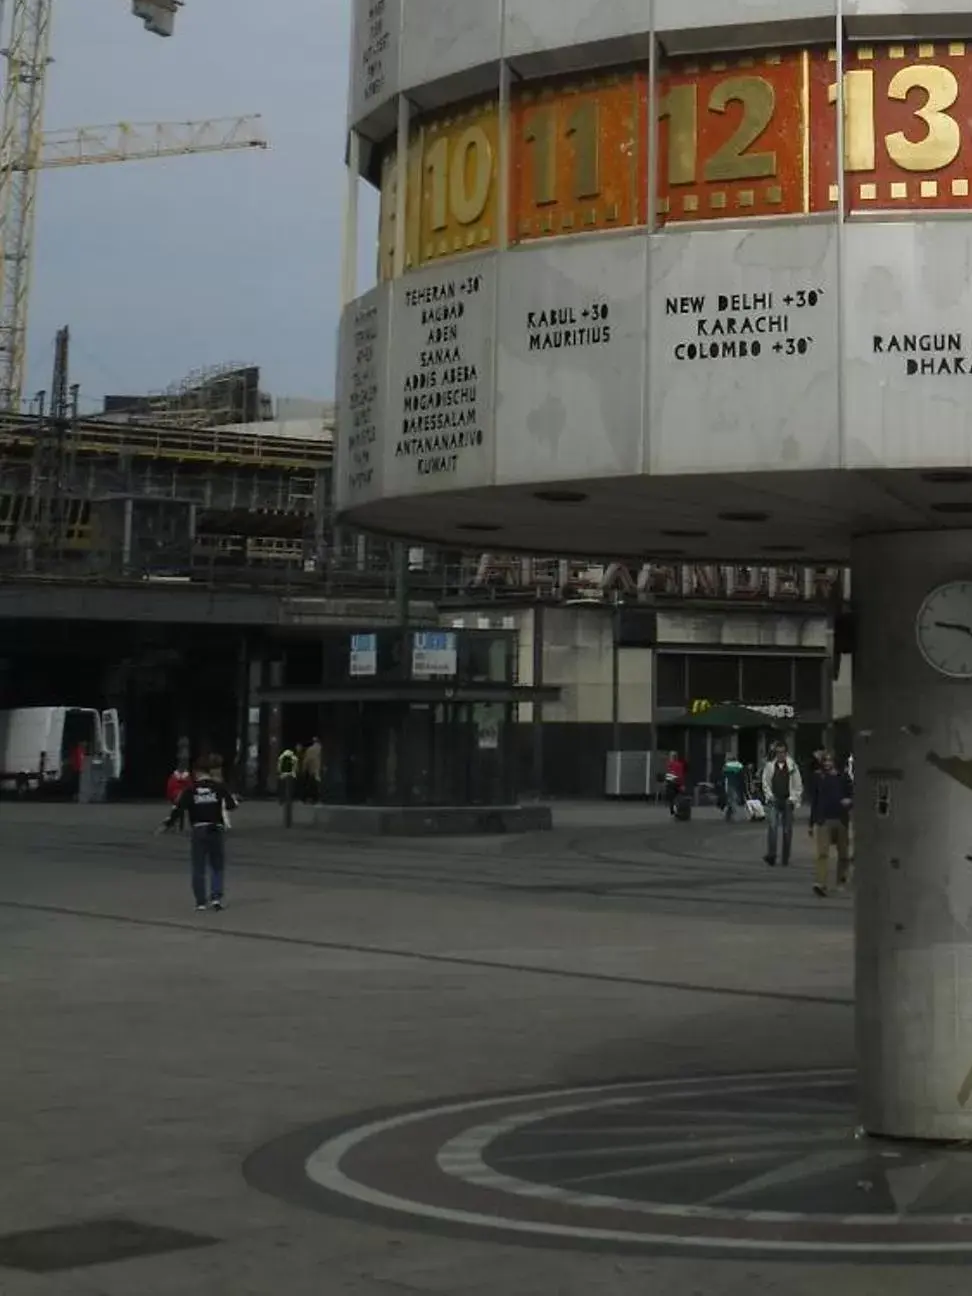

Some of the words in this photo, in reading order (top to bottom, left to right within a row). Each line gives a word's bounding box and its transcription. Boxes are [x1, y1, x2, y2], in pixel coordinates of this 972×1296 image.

[828, 64, 961, 171] 13
[658, 76, 777, 186] 12
[525, 98, 600, 206] 11
[423, 125, 492, 231] 10
[666, 296, 706, 315] NEW
[718, 292, 773, 312] DELHI
[527, 307, 577, 329] KABUL
[697, 315, 789, 336] KARACHI
[529, 326, 611, 351] MAURITIUS
[675, 340, 761, 360] COLOMBO
[874, 334, 962, 353] RANGUN
[404, 371, 437, 392] ADDIS
